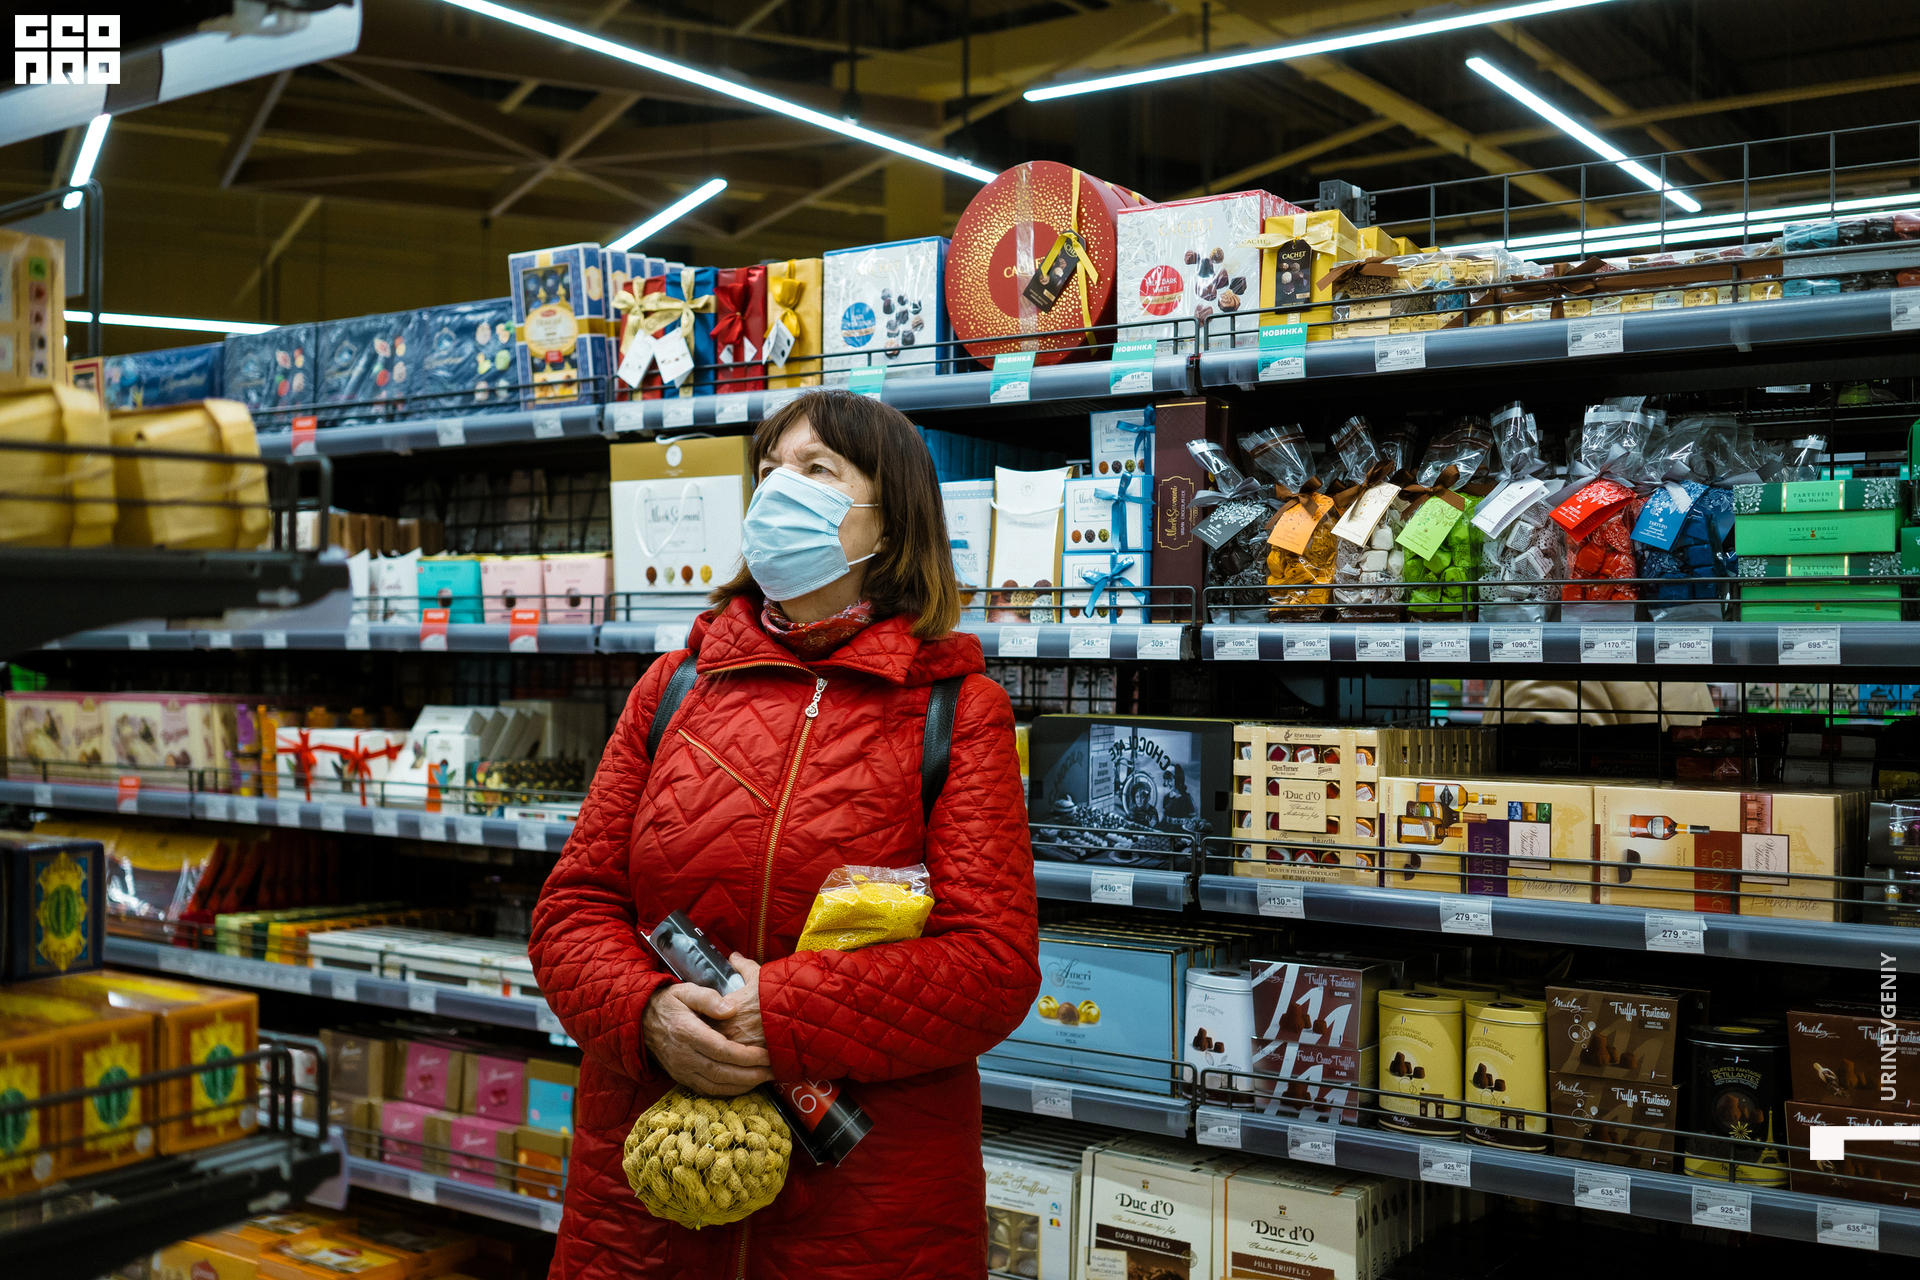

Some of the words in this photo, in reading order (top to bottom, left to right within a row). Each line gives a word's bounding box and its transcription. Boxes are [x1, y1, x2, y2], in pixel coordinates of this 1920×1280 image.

[1159, 218, 1214, 238] CACHET
[1282, 250, 1307, 260] CACHET
[1262, 327, 1303, 337] НОВИНКА
[1115, 344, 1152, 354] НОВИНКА
[997, 355, 1031, 364] НОВИНКА
[1282, 790, 1303, 800] Duc
[1305, 791, 1321, 801] d'O
[1559, 882, 1580, 895] taste
[1796, 900, 1820, 912] taste
[1610, 1001, 1637, 1022] Truffes
[1639, 1004, 1671, 1020] Fantaisie
[1398, 1031, 1435, 1048] CHAMPAGNE
[1482, 1042, 1516, 1060] CHAMPAGNE
[1711, 1066, 1735, 1074] TRUFFES
[1611, 1087, 1638, 1108] Truffes
[1640, 1090, 1671, 1107] Fantaisie
[1115, 1193, 1147, 1211] Duc
[1150, 1200, 1174, 1216] d'O
[1251, 1219, 1285, 1238] Duc
[1289, 1226, 1315, 1243] d'O
[1115, 1231, 1135, 1242] DARK
[1136, 1236, 1171, 1249] TRUFFLES
[1254, 1260, 1273, 1270] MILK
[1275, 1263, 1311, 1277] TRUFFLES
